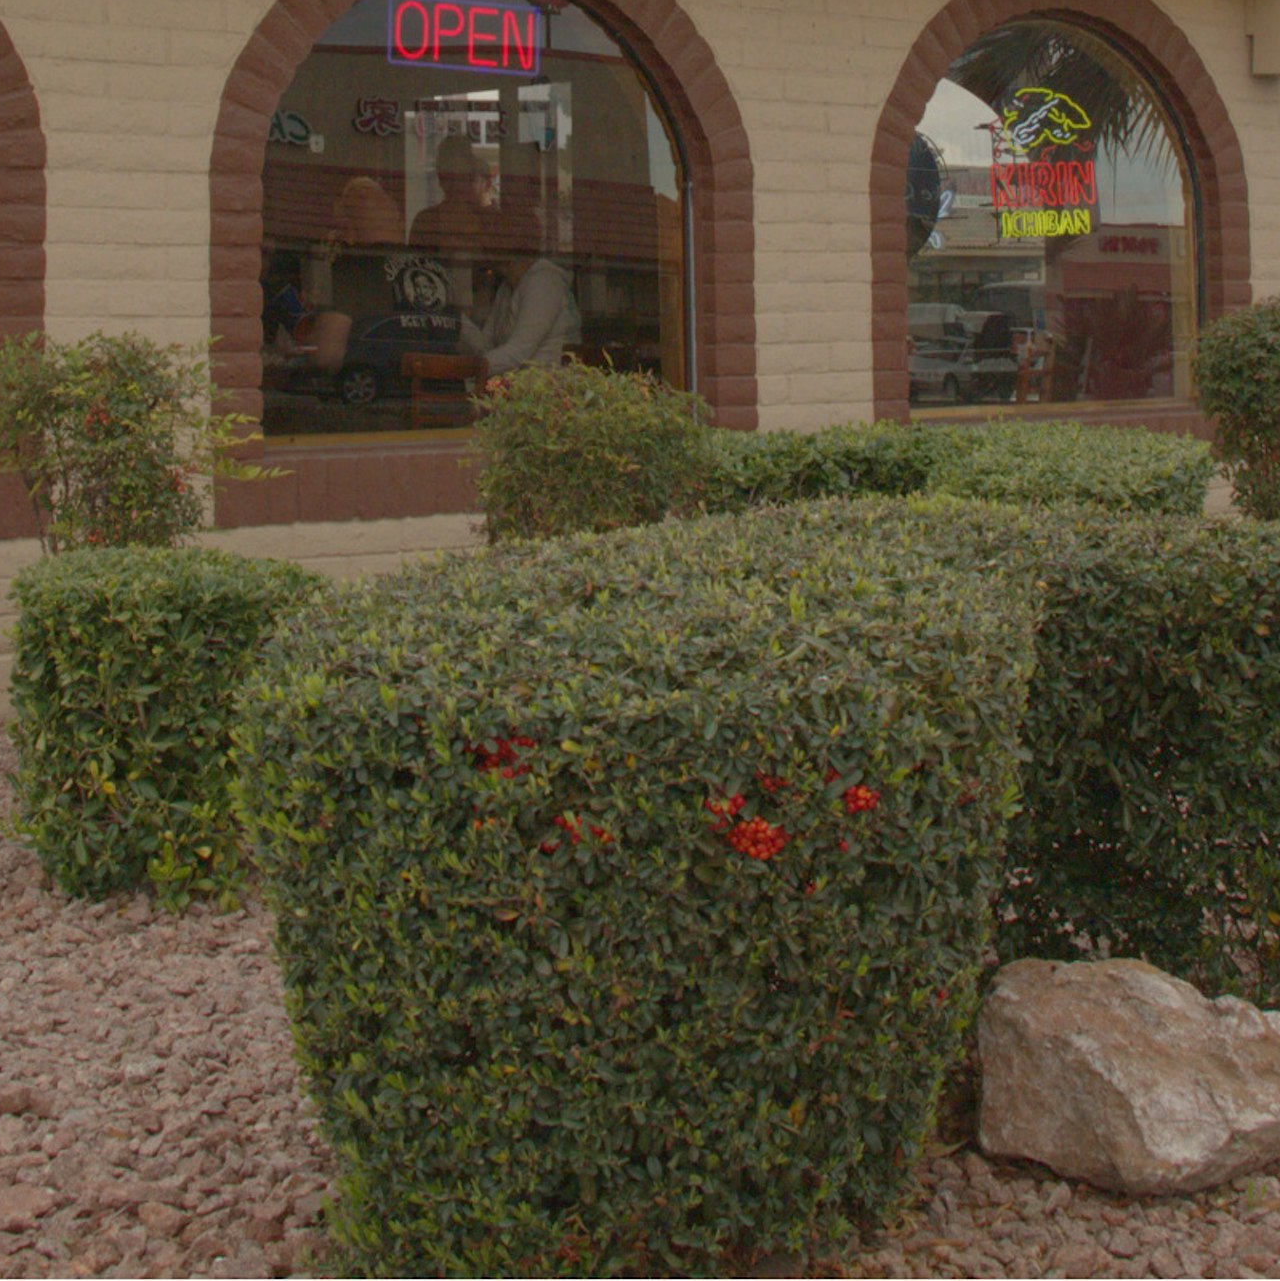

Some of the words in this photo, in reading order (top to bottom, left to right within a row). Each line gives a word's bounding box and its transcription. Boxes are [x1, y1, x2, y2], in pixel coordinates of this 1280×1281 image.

[394, 0, 535, 70] OPEN
[991, 161, 1097, 208] KIRIN
[1001, 209, 1091, 238] ICHIBAN
